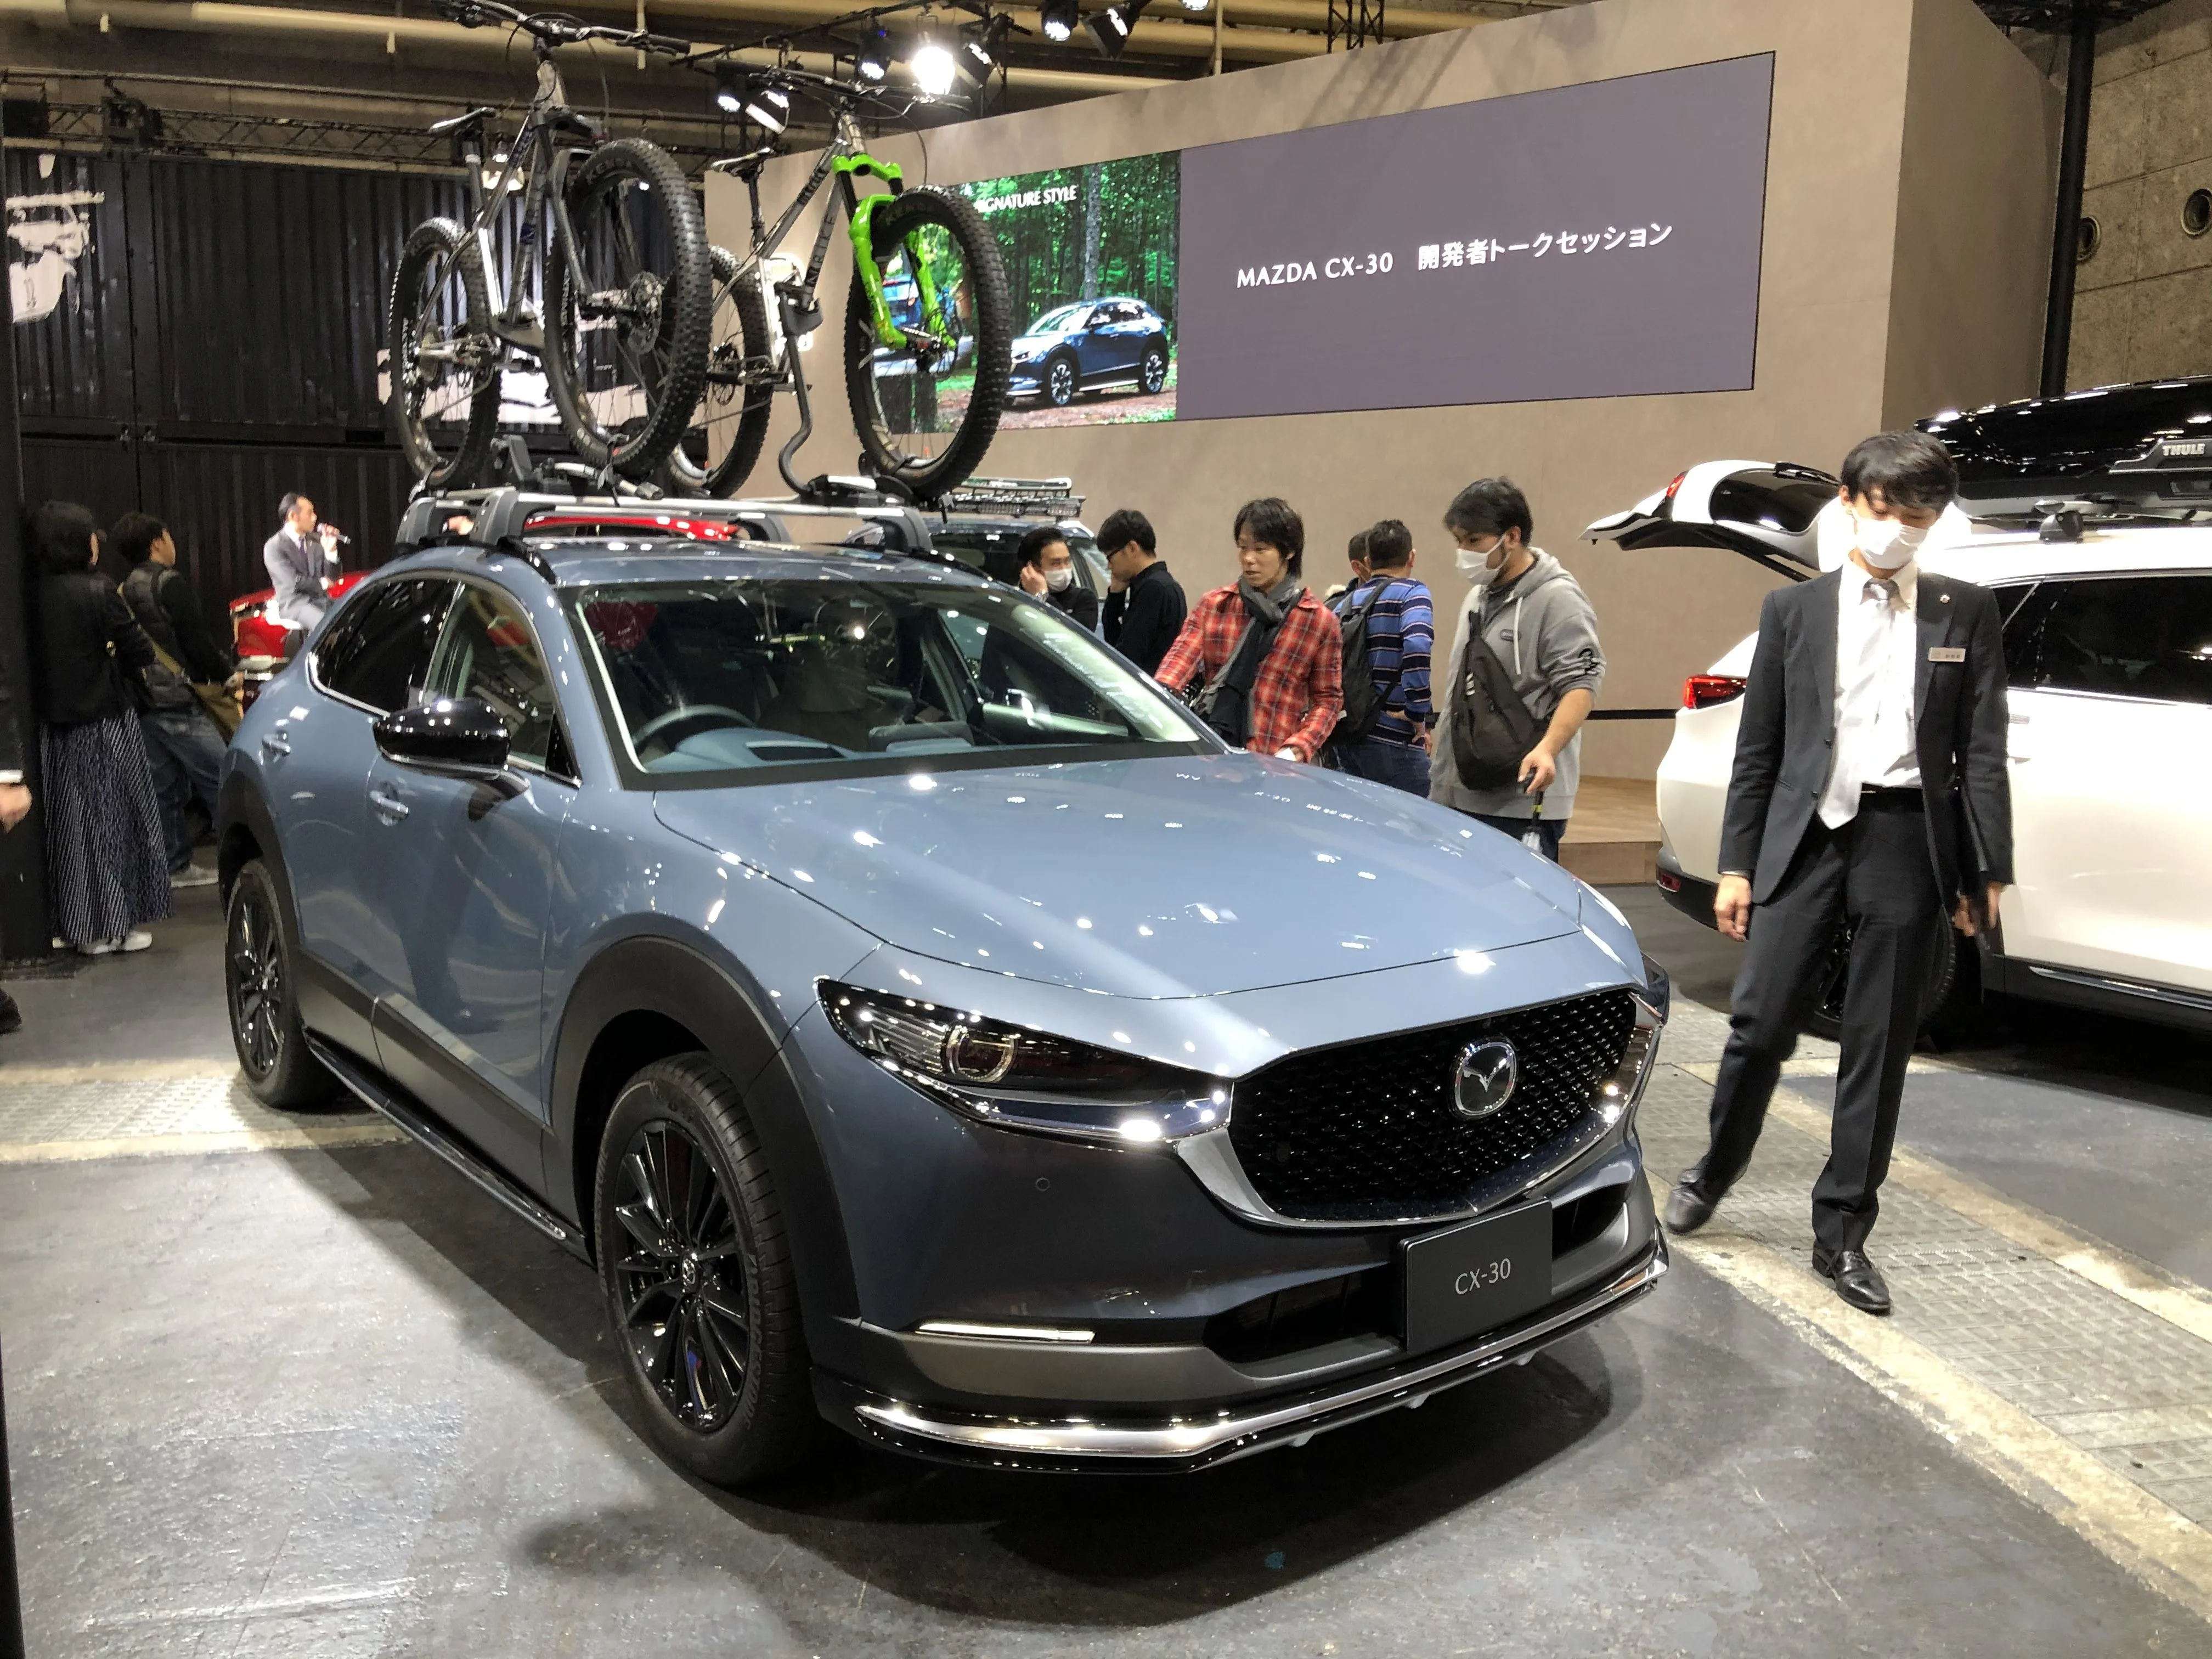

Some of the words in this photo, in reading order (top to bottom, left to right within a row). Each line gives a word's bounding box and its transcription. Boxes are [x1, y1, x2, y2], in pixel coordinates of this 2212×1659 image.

[1043, 184, 1077, 205] STYLE
[1237, 262, 1317, 287] MAZDA
[1325, 252, 1393, 278] CX-30
[1418, 223, 1672, 270] 開発者トークセッション
[2162, 443, 2205, 456] THULE
[1455, 1257, 1511, 1295] CX-30
